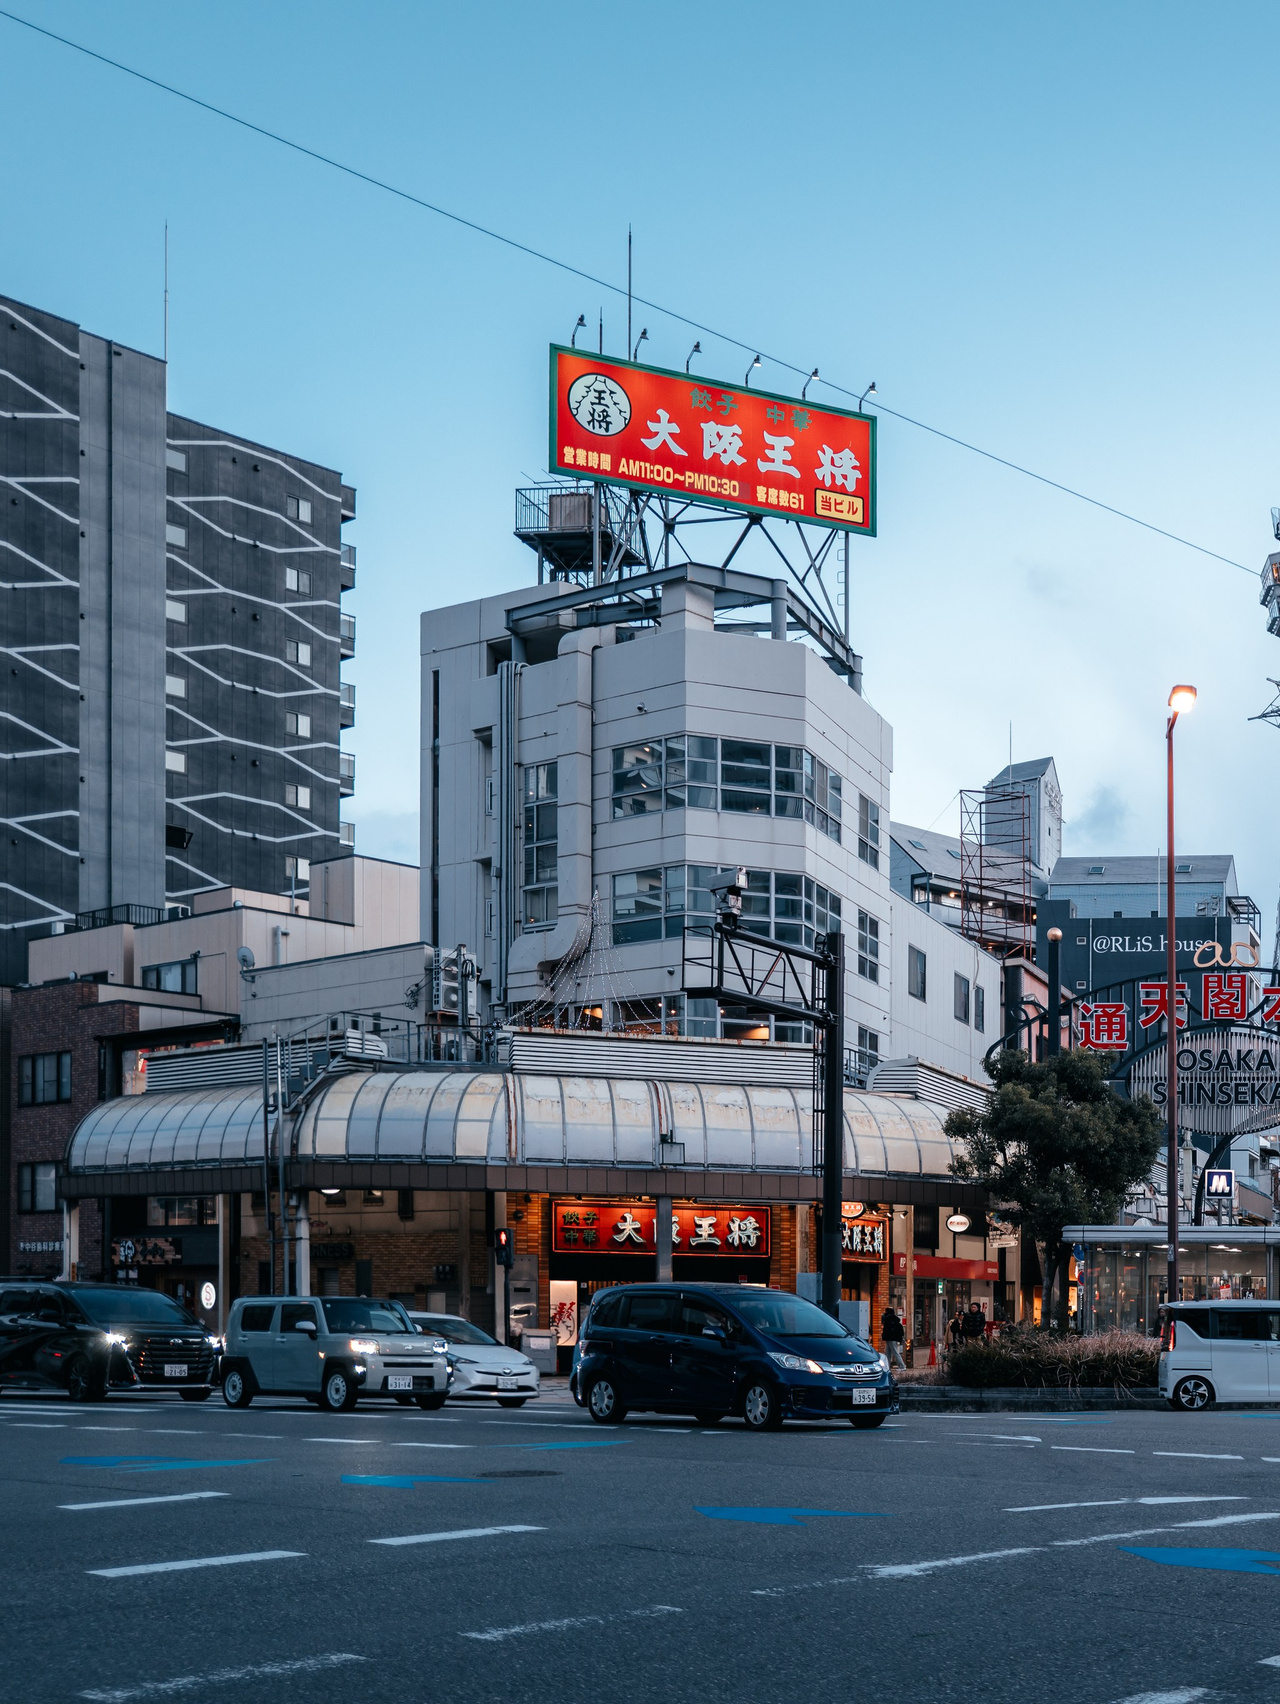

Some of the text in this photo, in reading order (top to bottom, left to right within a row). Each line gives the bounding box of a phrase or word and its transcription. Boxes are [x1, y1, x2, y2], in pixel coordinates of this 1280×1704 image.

[587, 387, 613, 433] 王将
[689, 387, 812, 432] 餃子 中華
[640, 409, 862, 491] 大阪王将
[563, 446, 611, 472] 営業時間
[820, 491, 858, 516] 当ビル
[1176, 1048, 1276, 1072] OSAKA
[562, 1210, 598, 1225] 餃子
[564, 1230, 597, 1243] 中華
[842, 1221, 883, 1254] 大阪王将
